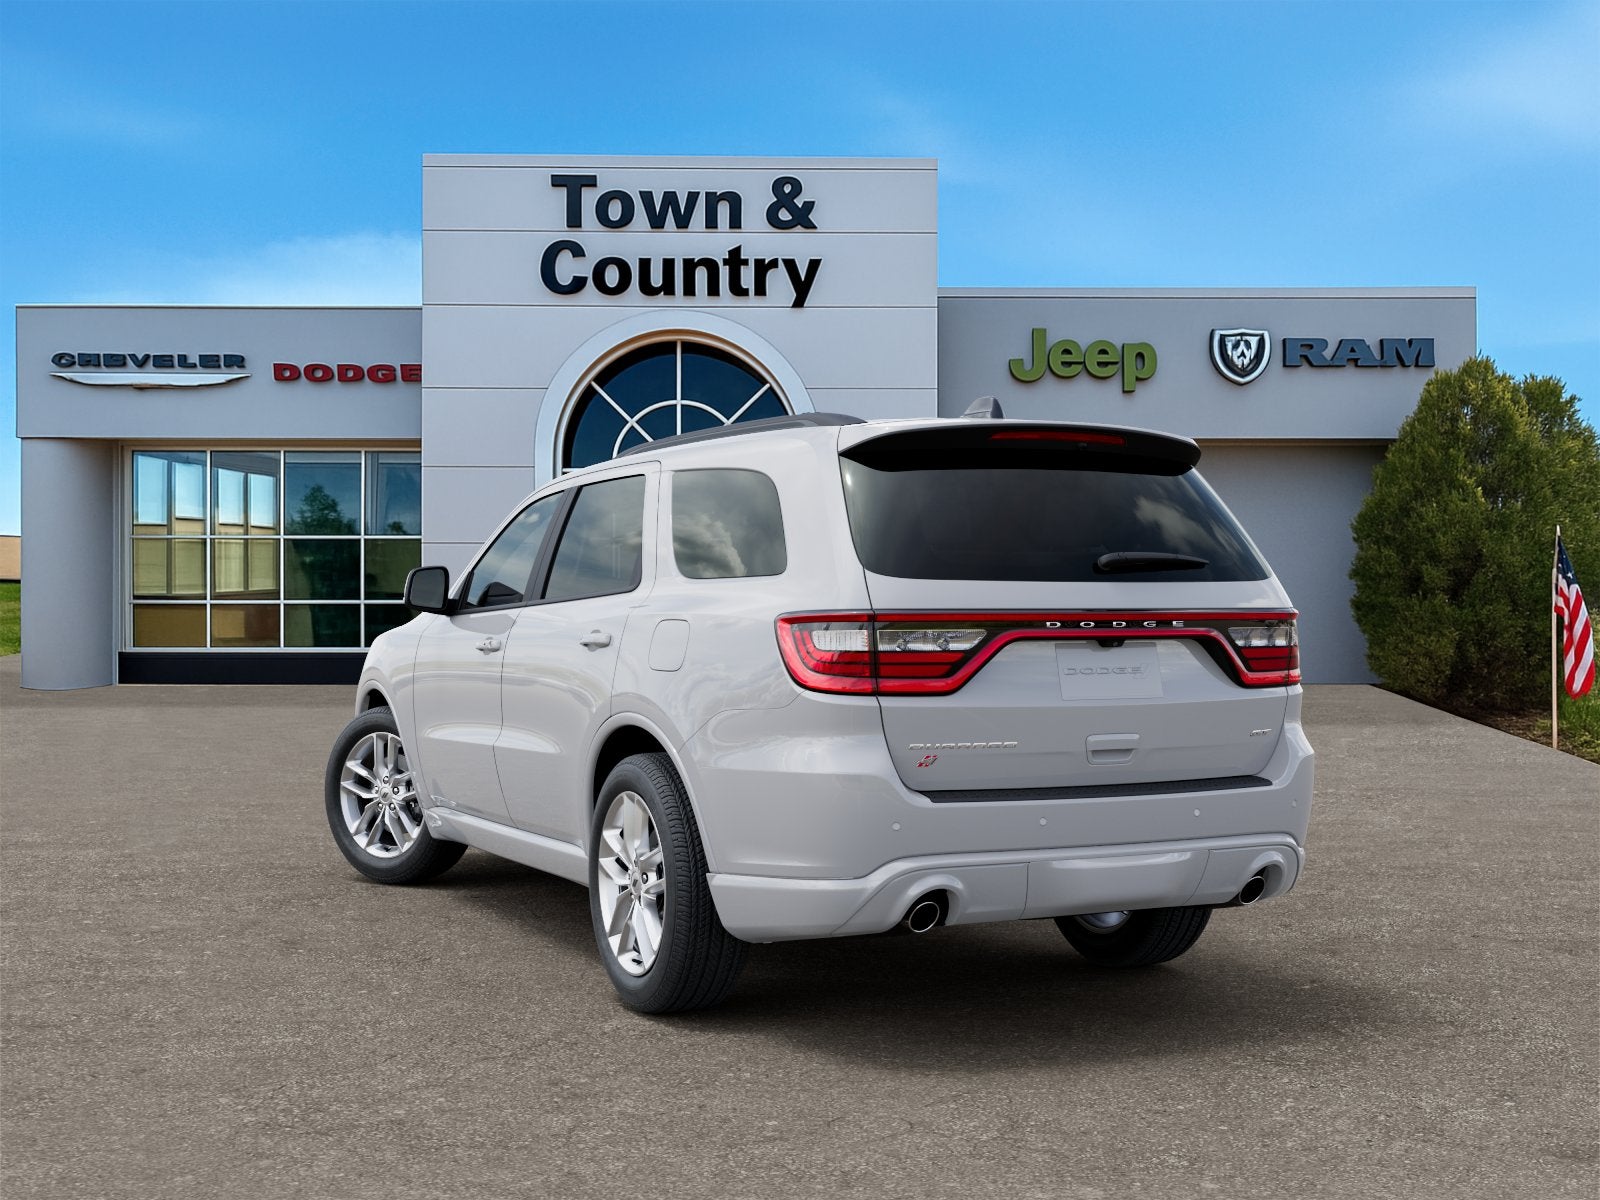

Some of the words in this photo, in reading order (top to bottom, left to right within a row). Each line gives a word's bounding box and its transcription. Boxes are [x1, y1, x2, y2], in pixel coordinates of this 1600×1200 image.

[550, 173, 742, 229] Town
[765, 175, 818, 230] &
[540, 239, 822, 308] Country
[1009, 328, 1157, 393] Jeep
[1282, 337, 1435, 368] RAM
[273, 363, 422, 383] DODGE
[1046, 620, 1185, 628] DODGE
[1063, 666, 1144, 676] DODGE
